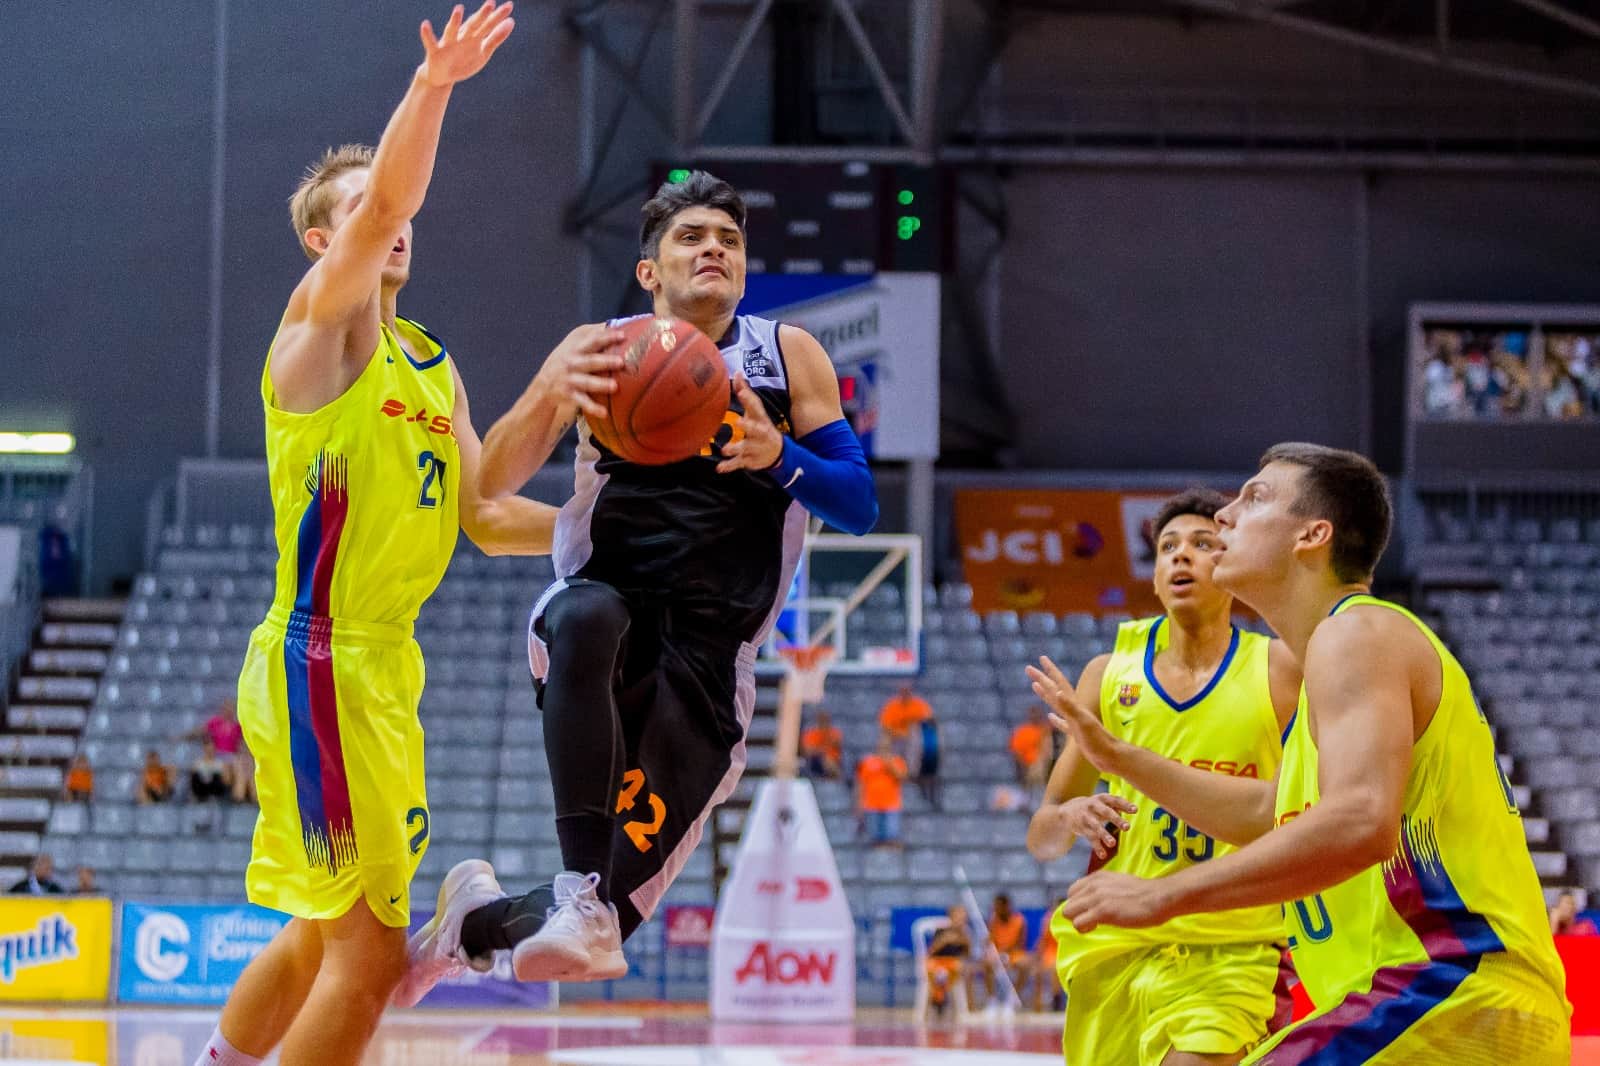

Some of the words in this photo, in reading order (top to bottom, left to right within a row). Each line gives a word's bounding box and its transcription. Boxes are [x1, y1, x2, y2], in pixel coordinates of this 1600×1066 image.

[1170, 759, 1259, 779] SSA
[615, 768, 667, 853] 42
[1151, 806, 1215, 862] 35
